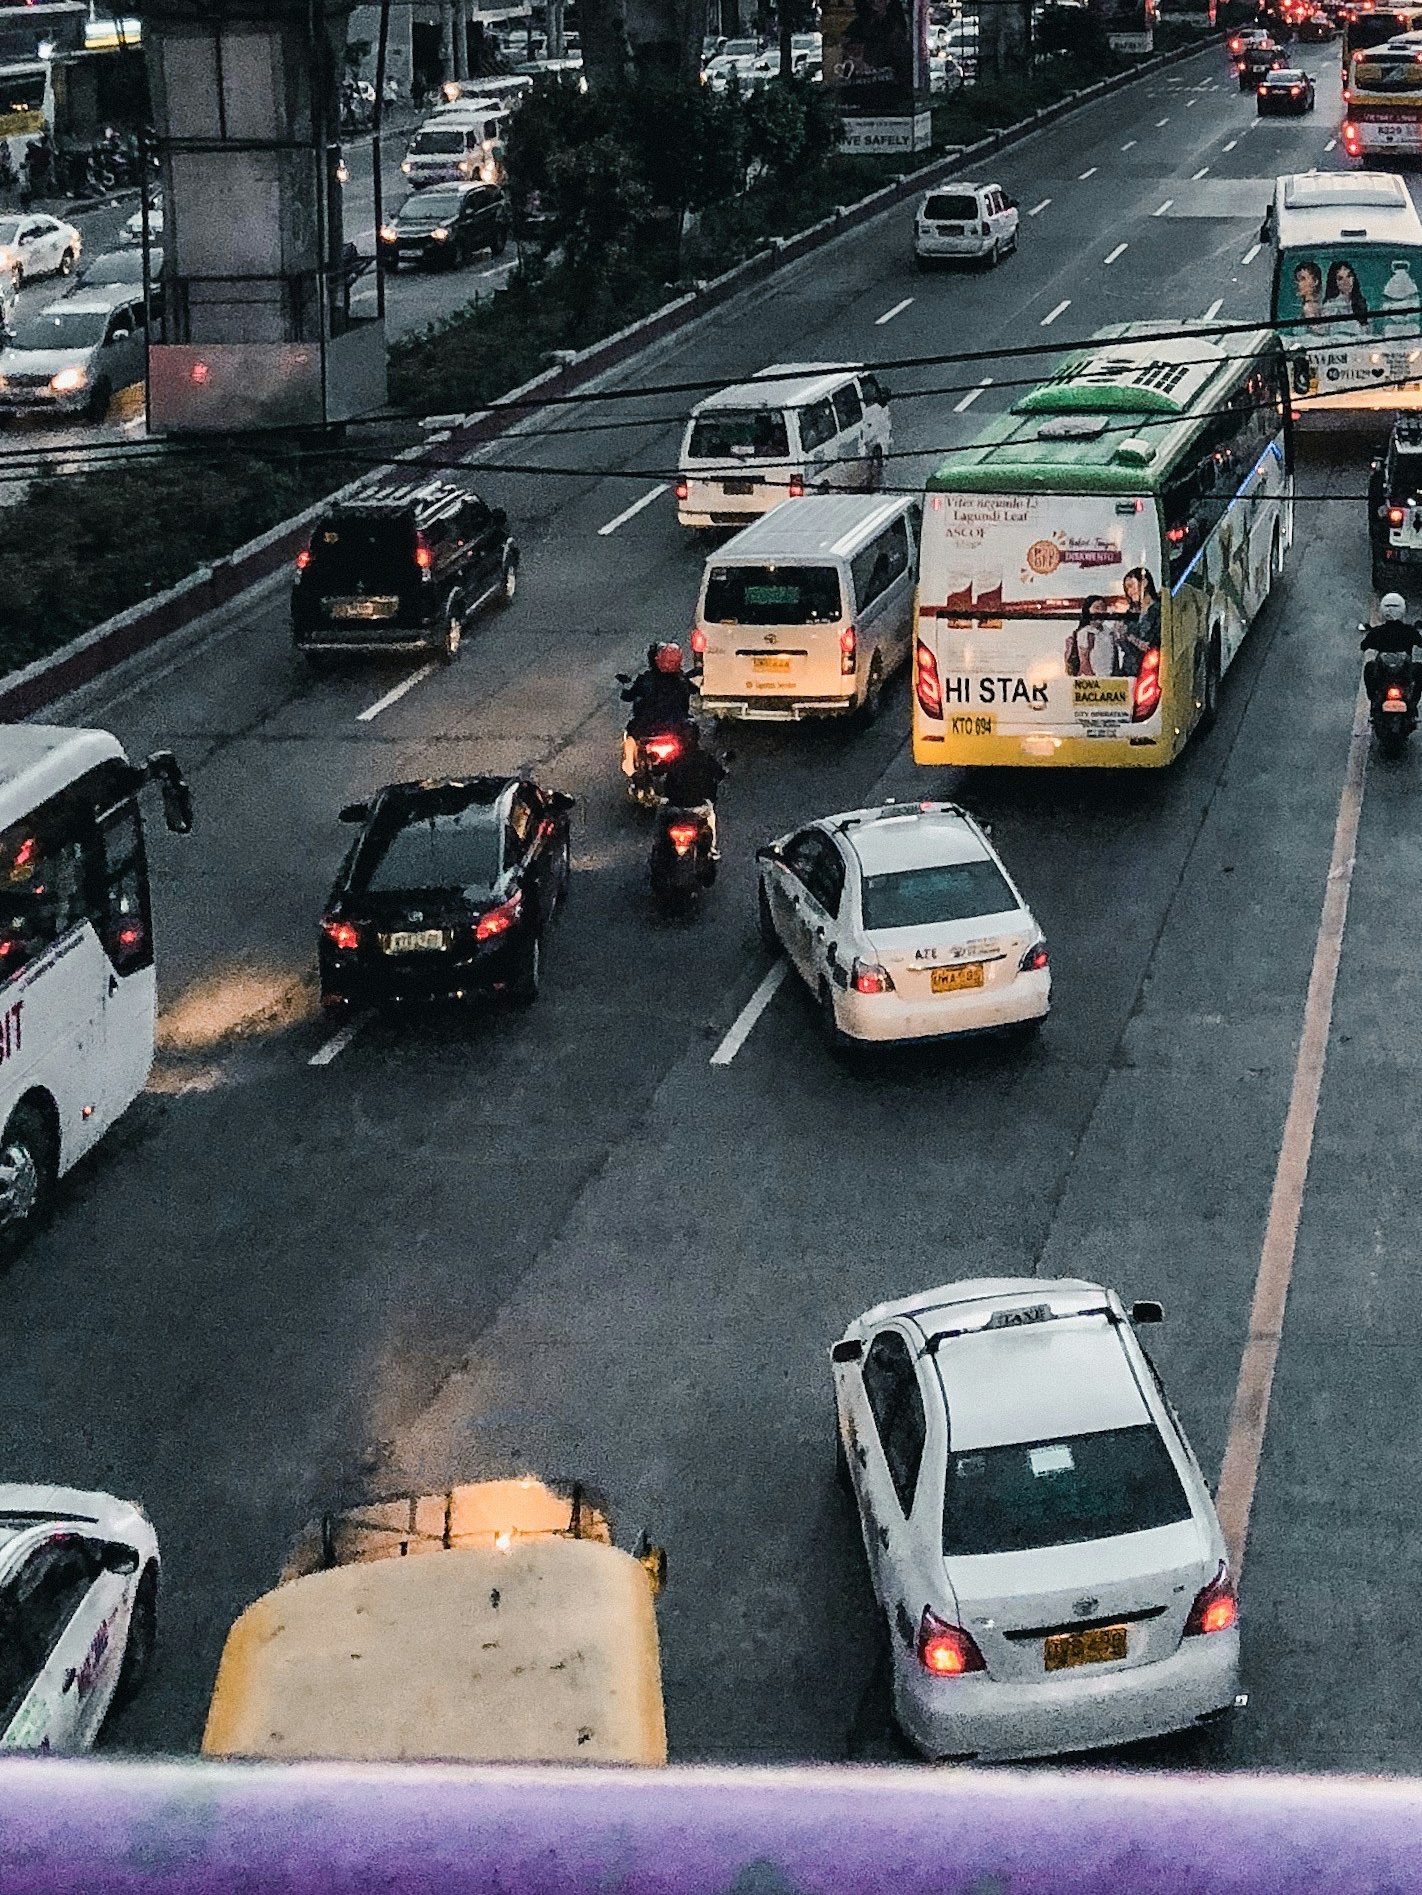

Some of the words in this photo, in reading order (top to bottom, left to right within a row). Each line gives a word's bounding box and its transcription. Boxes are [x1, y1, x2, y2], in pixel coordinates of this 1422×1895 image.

[864, 135, 909, 146] SAFELY
[945, 677, 970, 703] HI
[979, 677, 1049, 703] STAR
[1074, 691, 1126, 702] BACLARAN
[952, 716, 973, 735] KTO
